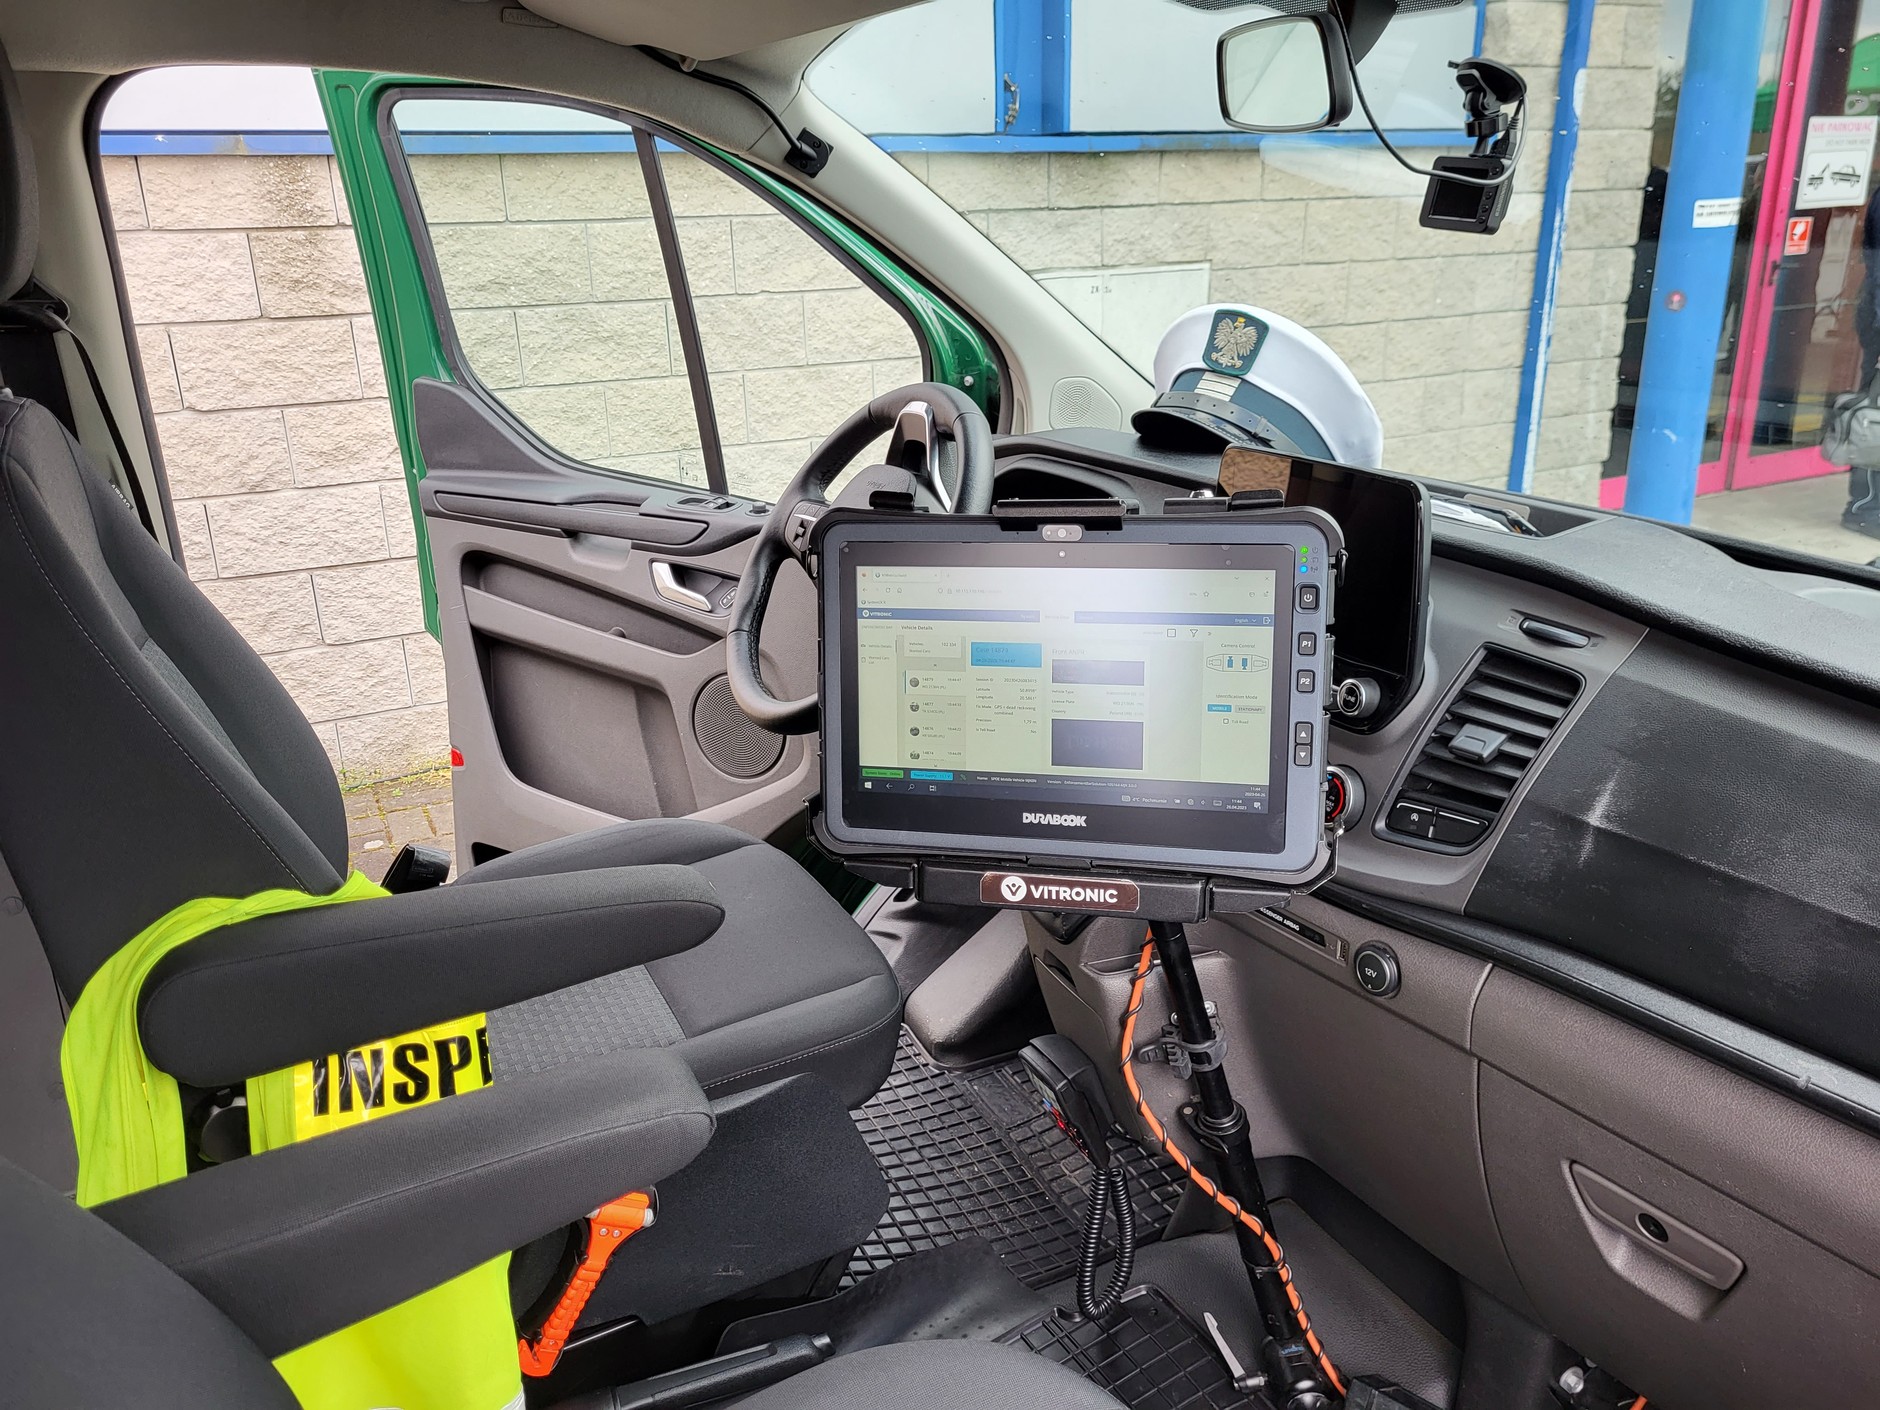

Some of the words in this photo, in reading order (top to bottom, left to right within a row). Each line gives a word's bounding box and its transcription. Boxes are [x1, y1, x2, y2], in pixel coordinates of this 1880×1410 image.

[1301, 640, 1312, 648] P1
[1300, 677, 1310, 685] P2
[1022, 812, 1087, 827] DURABOOK
[1030, 884, 1118, 903] VITRONIC
[1364, 967, 1377, 978] 12V
